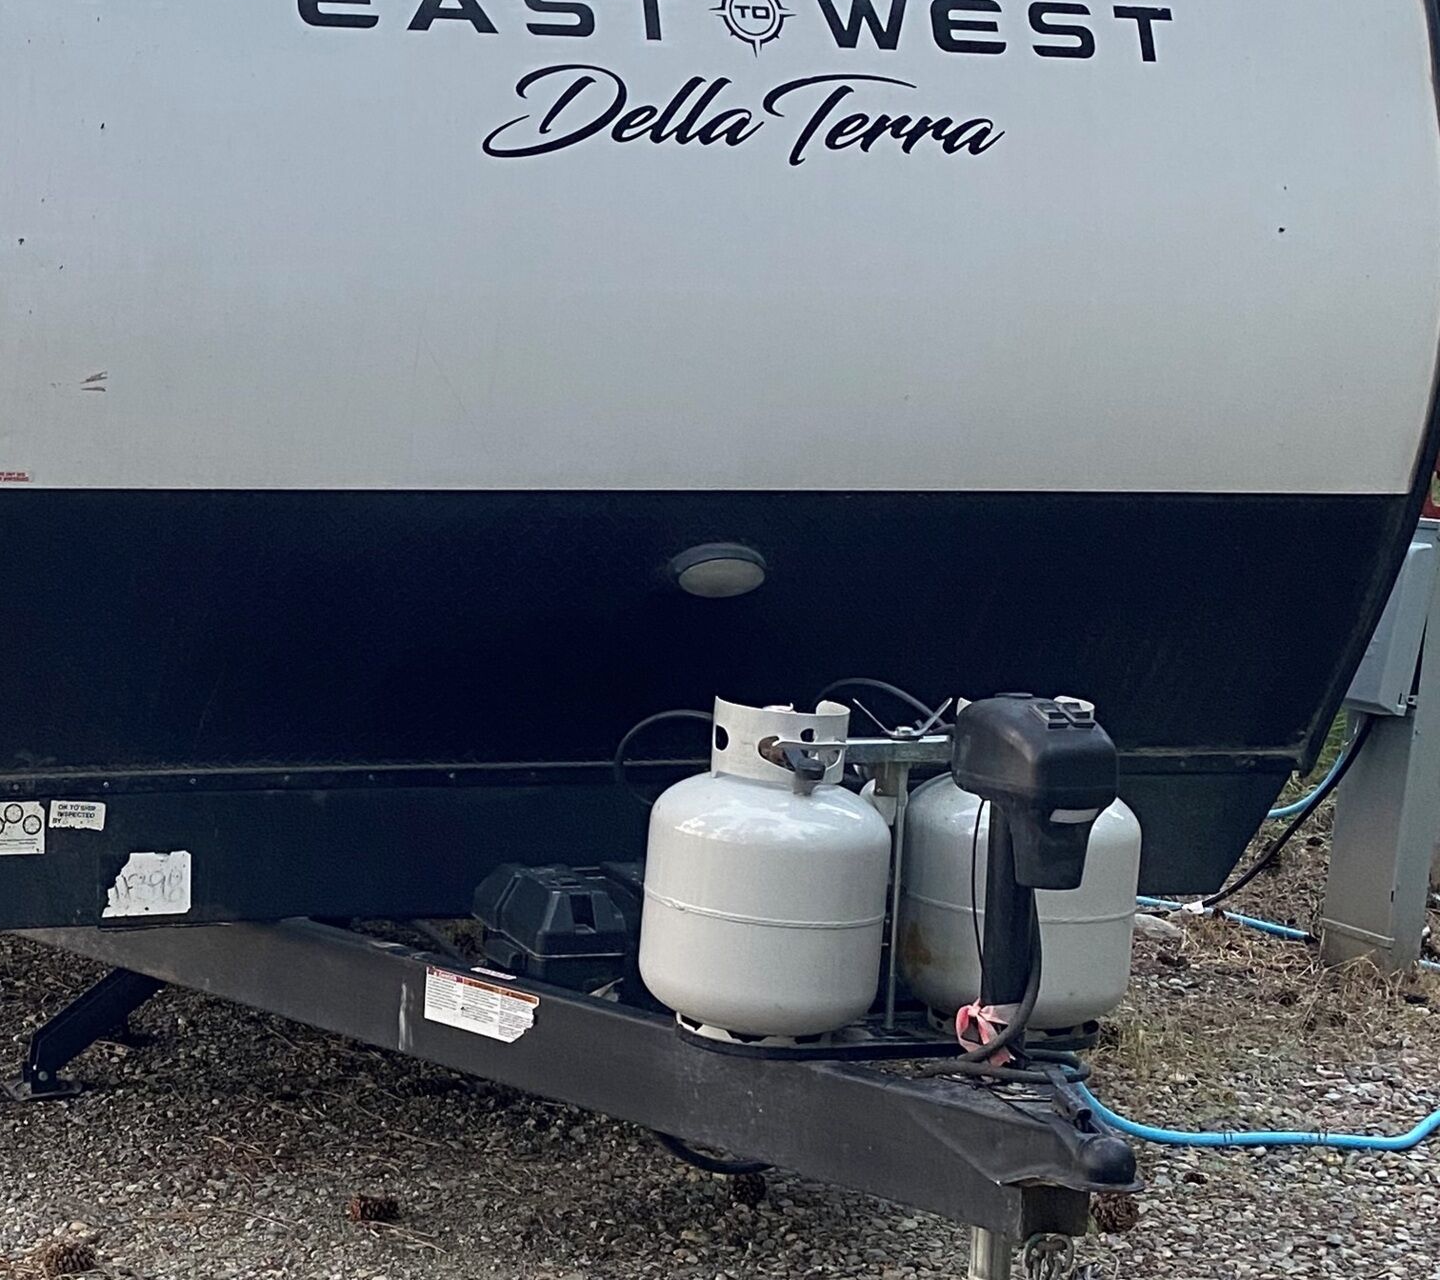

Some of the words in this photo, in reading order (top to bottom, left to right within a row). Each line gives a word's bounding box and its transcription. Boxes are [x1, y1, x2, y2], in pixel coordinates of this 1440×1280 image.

[734, 4, 771, 20] TO
[482, 64, 765, 158] Della
[762, 74, 1006, 166] Terra
